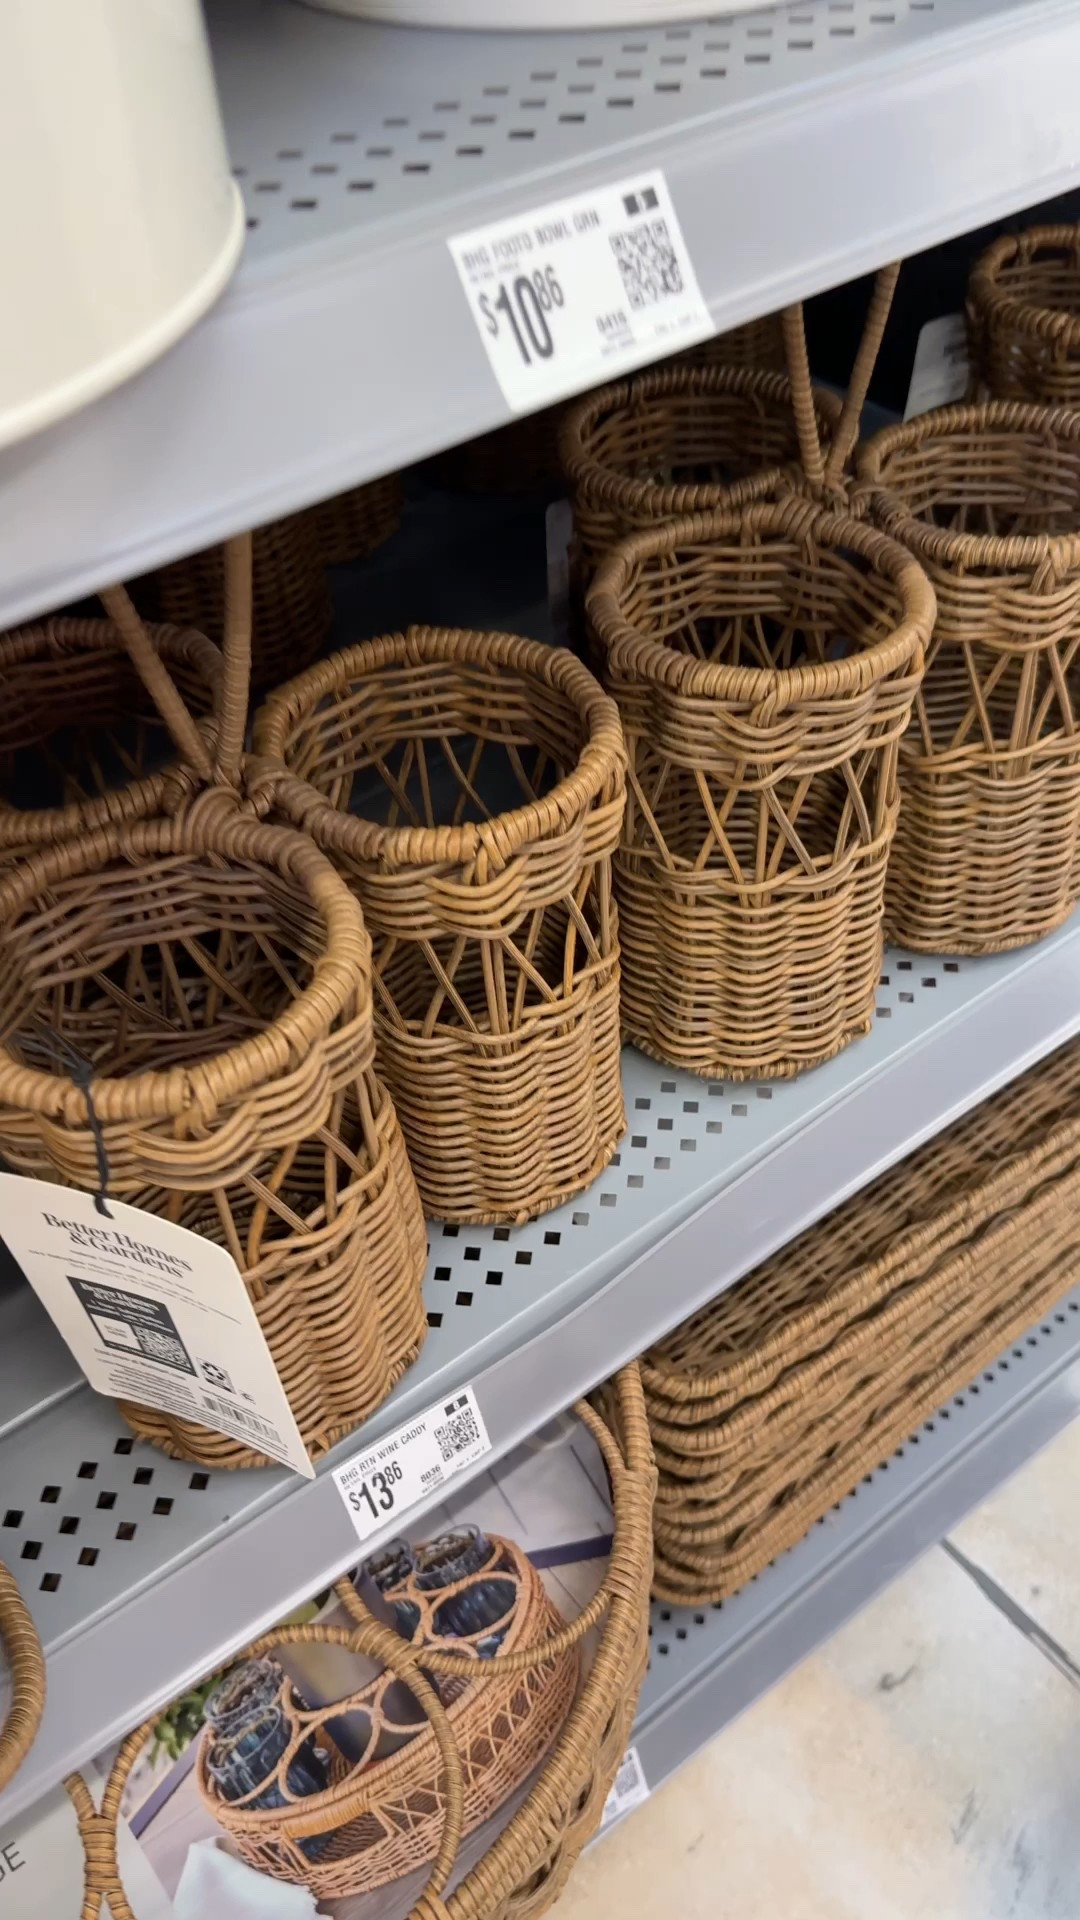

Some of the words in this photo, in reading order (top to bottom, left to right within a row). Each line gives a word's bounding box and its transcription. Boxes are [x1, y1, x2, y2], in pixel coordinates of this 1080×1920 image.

[534, 220, 572, 245] BOWL
[40, 1211, 111, 1242] Better
[111, 1231, 194, 1273] Homes
[340, 1468, 359, 1485] BHG
[359, 1456, 377, 1473] RTN
[377, 1442, 400, 1461] WINE
[401, 1422, 428, 1445] CADDY
